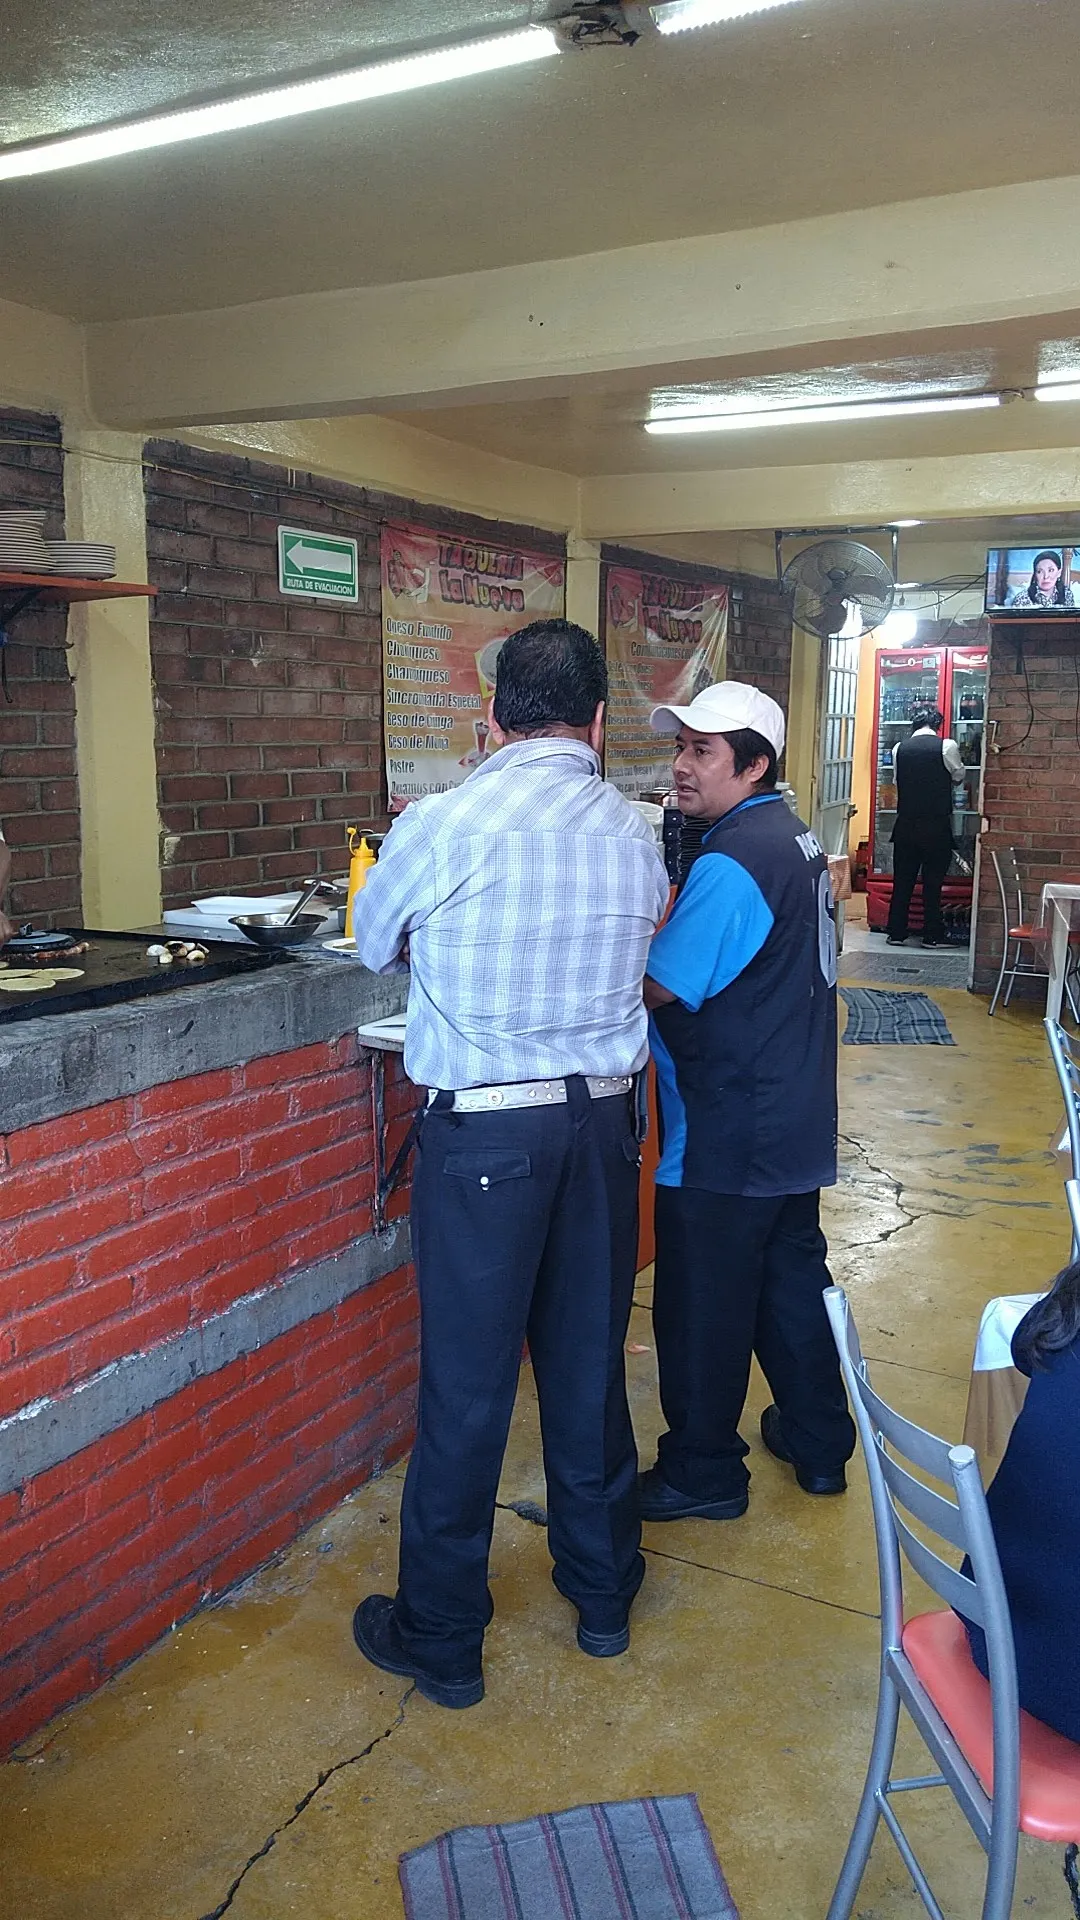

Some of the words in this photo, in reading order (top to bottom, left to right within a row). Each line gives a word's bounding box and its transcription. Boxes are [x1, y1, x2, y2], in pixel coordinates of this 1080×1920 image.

[286, 578, 304, 589] RUTA
[305, 580, 314, 590] DE
[314, 582, 353, 595] EVACUACION
[386, 616, 415, 636] Queso
[417, 621, 453, 641] Fundido
[447, 693, 481, 710] Especial
[387, 711, 409, 727] Beso
[411, 713, 425, 728] de
[388, 734, 409, 749] Beso
[409, 735, 423, 749] de
[389, 758, 415, 774] Postre
